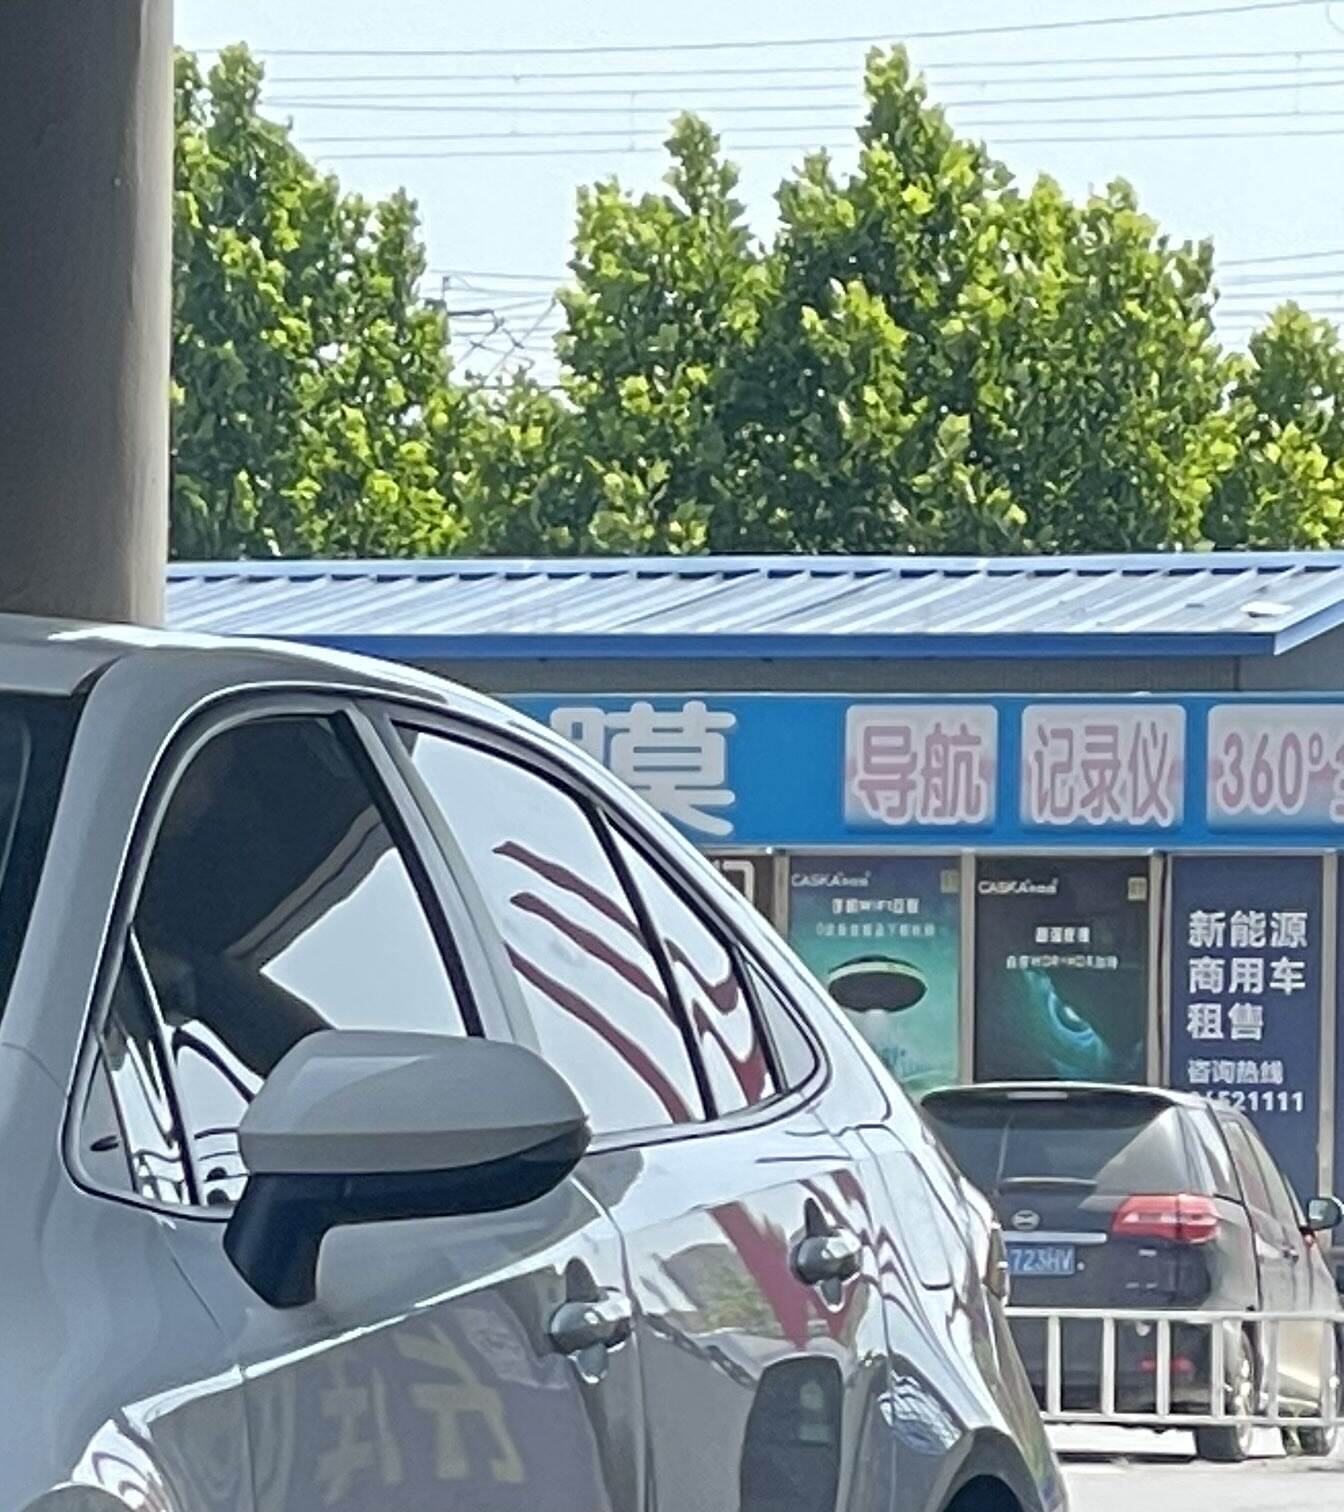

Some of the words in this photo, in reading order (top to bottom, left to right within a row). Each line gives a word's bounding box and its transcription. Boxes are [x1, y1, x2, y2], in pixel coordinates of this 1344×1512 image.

[857, 721, 983, 818] 导航
[1033, 719, 1170, 820] 记录仪
[1188, 910, 1308, 949] 新能源
[1188, 955, 1306, 995] 商用车
[1186, 1002, 1264, 1041] 租售
[1187, 1059, 1284, 1086] 咨询热线
